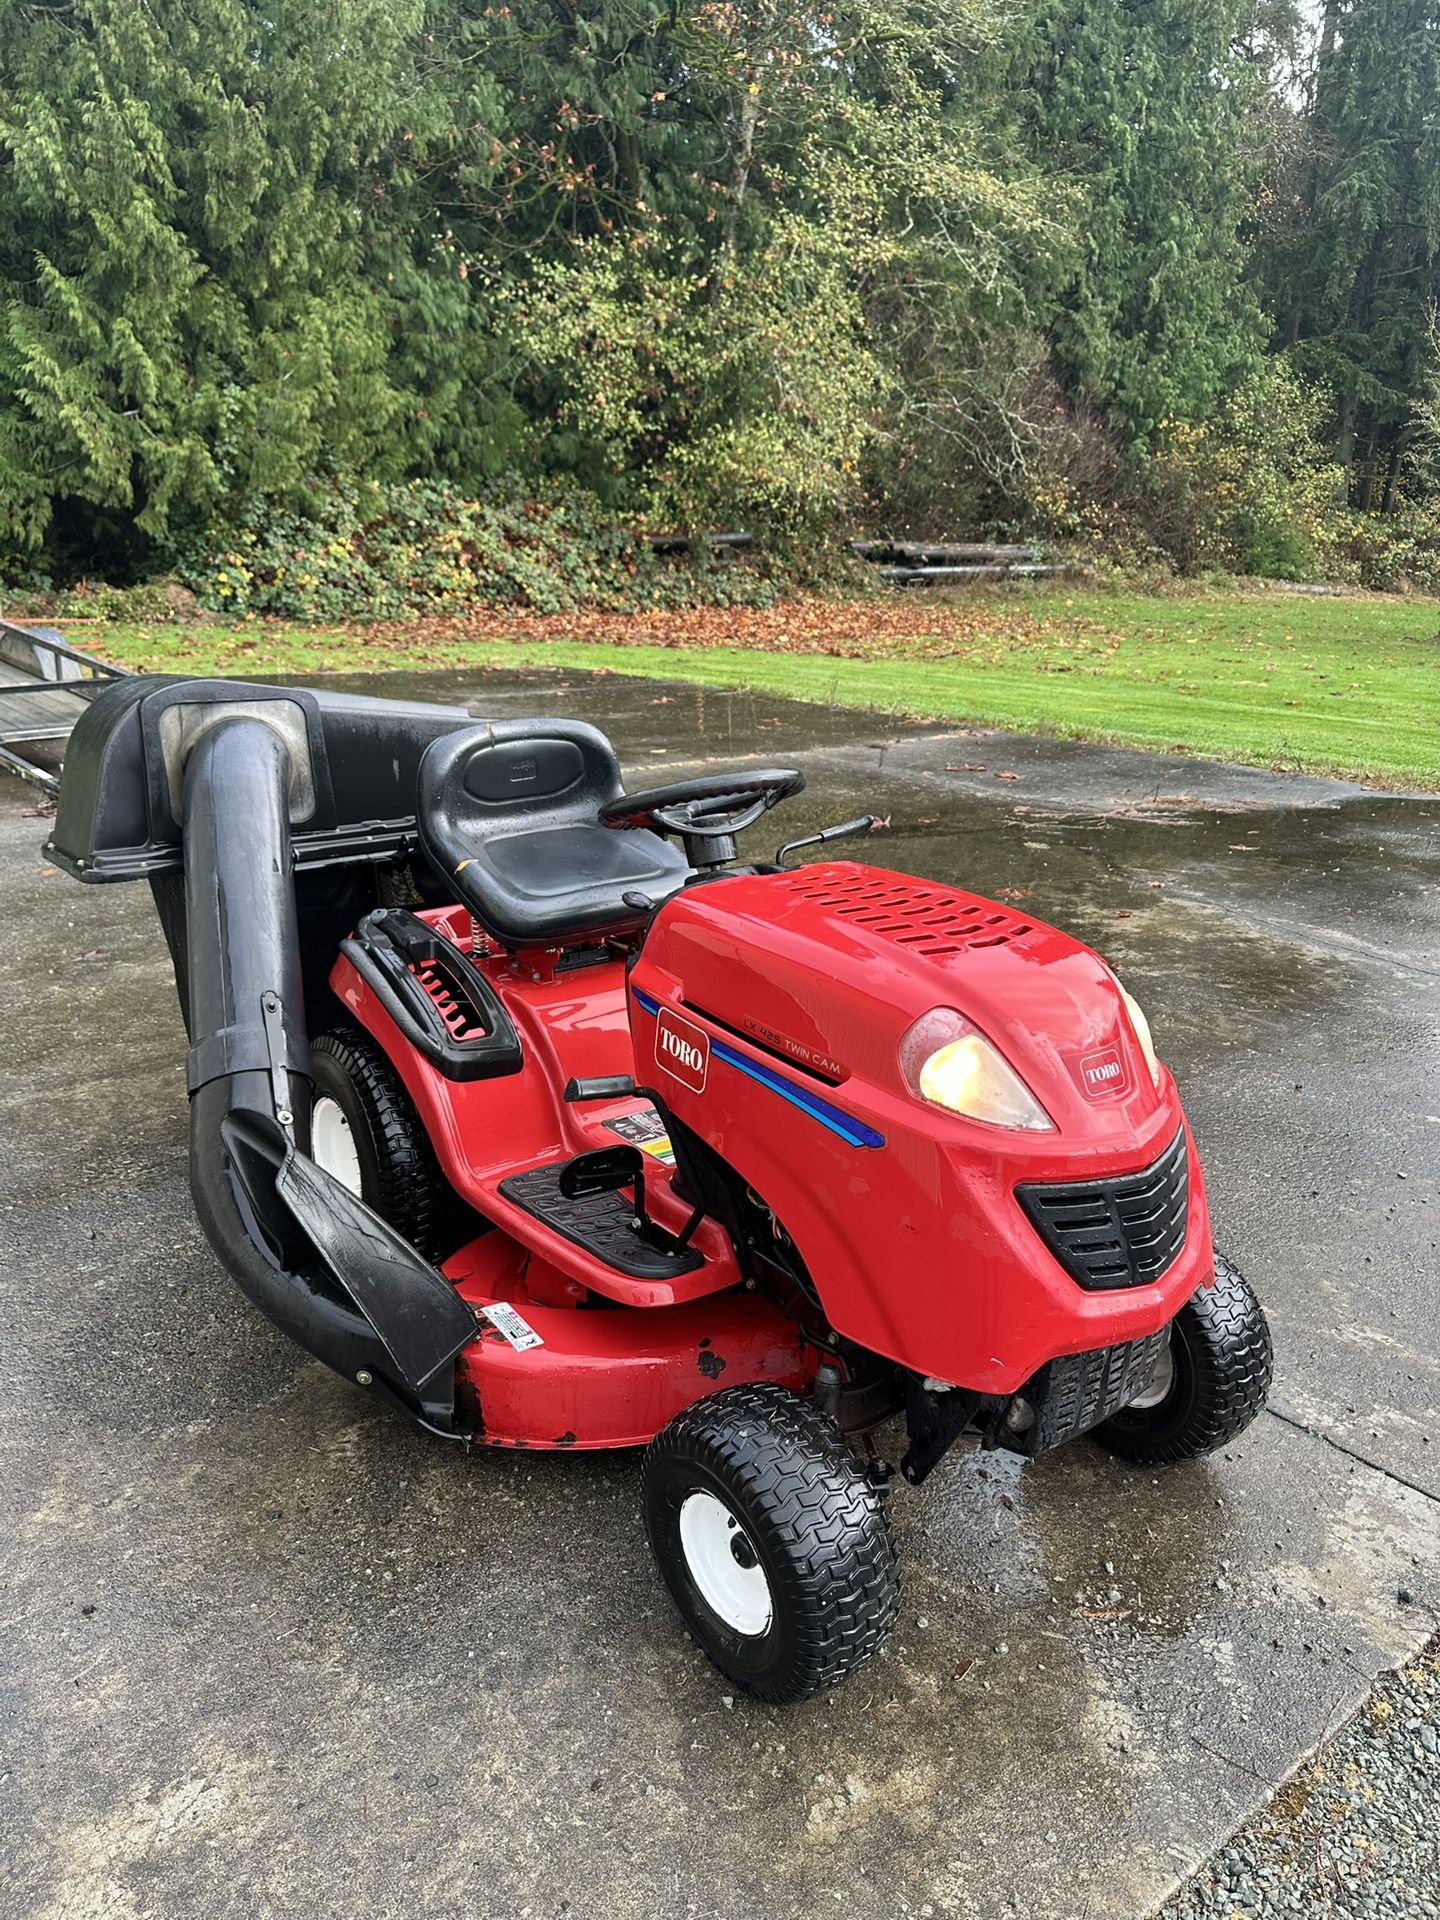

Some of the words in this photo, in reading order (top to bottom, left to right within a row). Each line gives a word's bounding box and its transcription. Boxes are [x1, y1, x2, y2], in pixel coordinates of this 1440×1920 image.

[660, 1026, 703, 1072] TORO
[743, 1018, 757, 1032] LX
[759, 1026, 782, 1045] 425
[784, 1039, 811, 1060] TWIN
[811, 1053, 841, 1075] CAM
[1085, 1061, 1121, 1084] TORO
